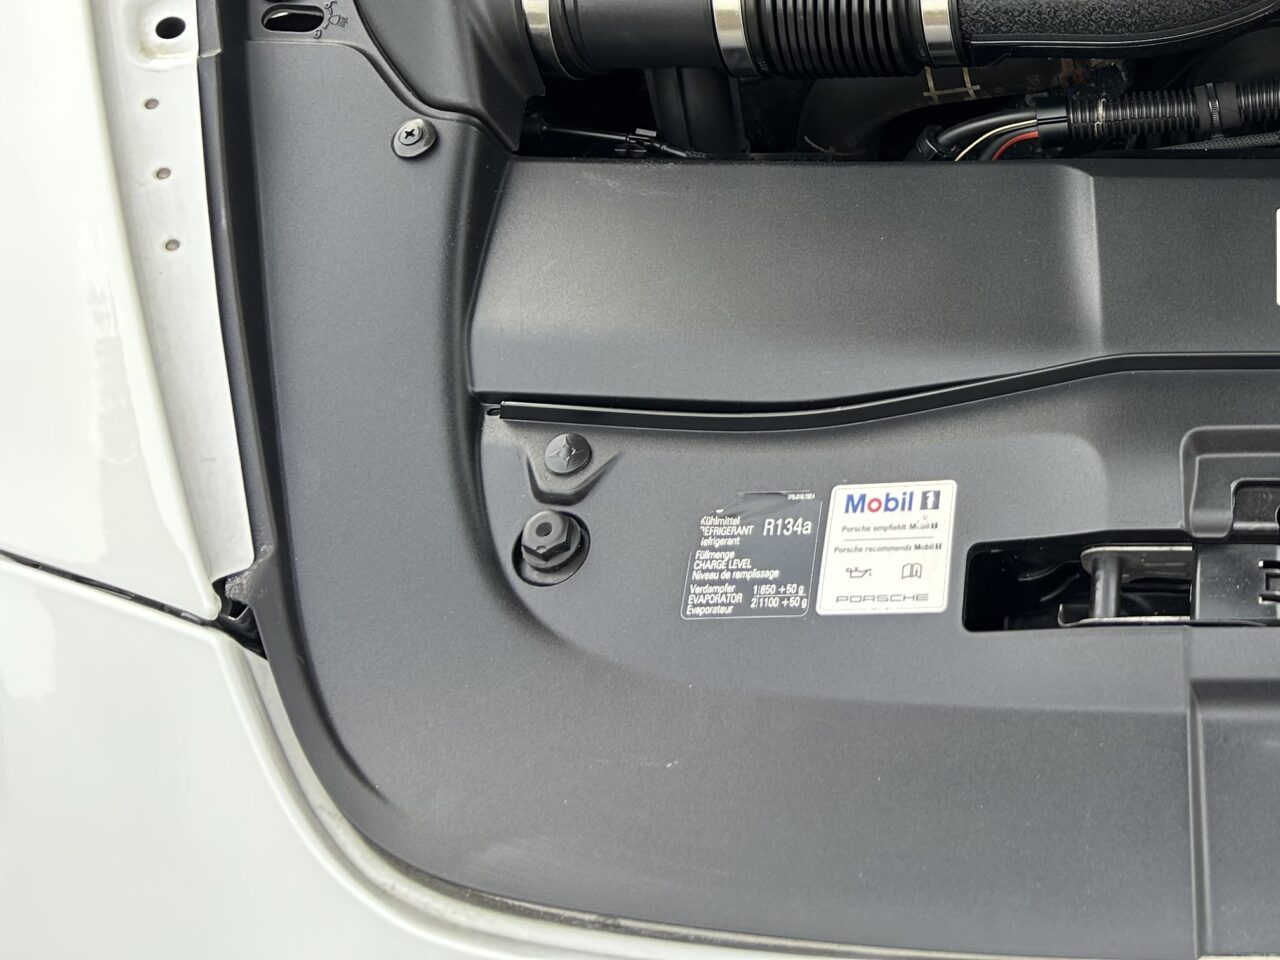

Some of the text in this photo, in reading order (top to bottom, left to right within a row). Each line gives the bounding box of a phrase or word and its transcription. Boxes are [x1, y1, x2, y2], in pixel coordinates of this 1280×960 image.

[844, 491, 914, 514] Mobil
[762, 517, 812, 536] R134a
[841, 524, 871, 533] Porsche
[833, 545, 864, 553] Porsche
[865, 543, 912, 553] recommends
[913, 542, 935, 551] Mobil
[694, 550, 736, 561] Füllmenge
[693, 559, 752, 570] CHARGE LEVEL
[691, 568, 780, 581] Niveau de remplissage
[689, 583, 736, 595] Verdampfer
[687, 593, 743, 605] EVAPORATOR
[835, 592, 930, 604] PORSCHE
